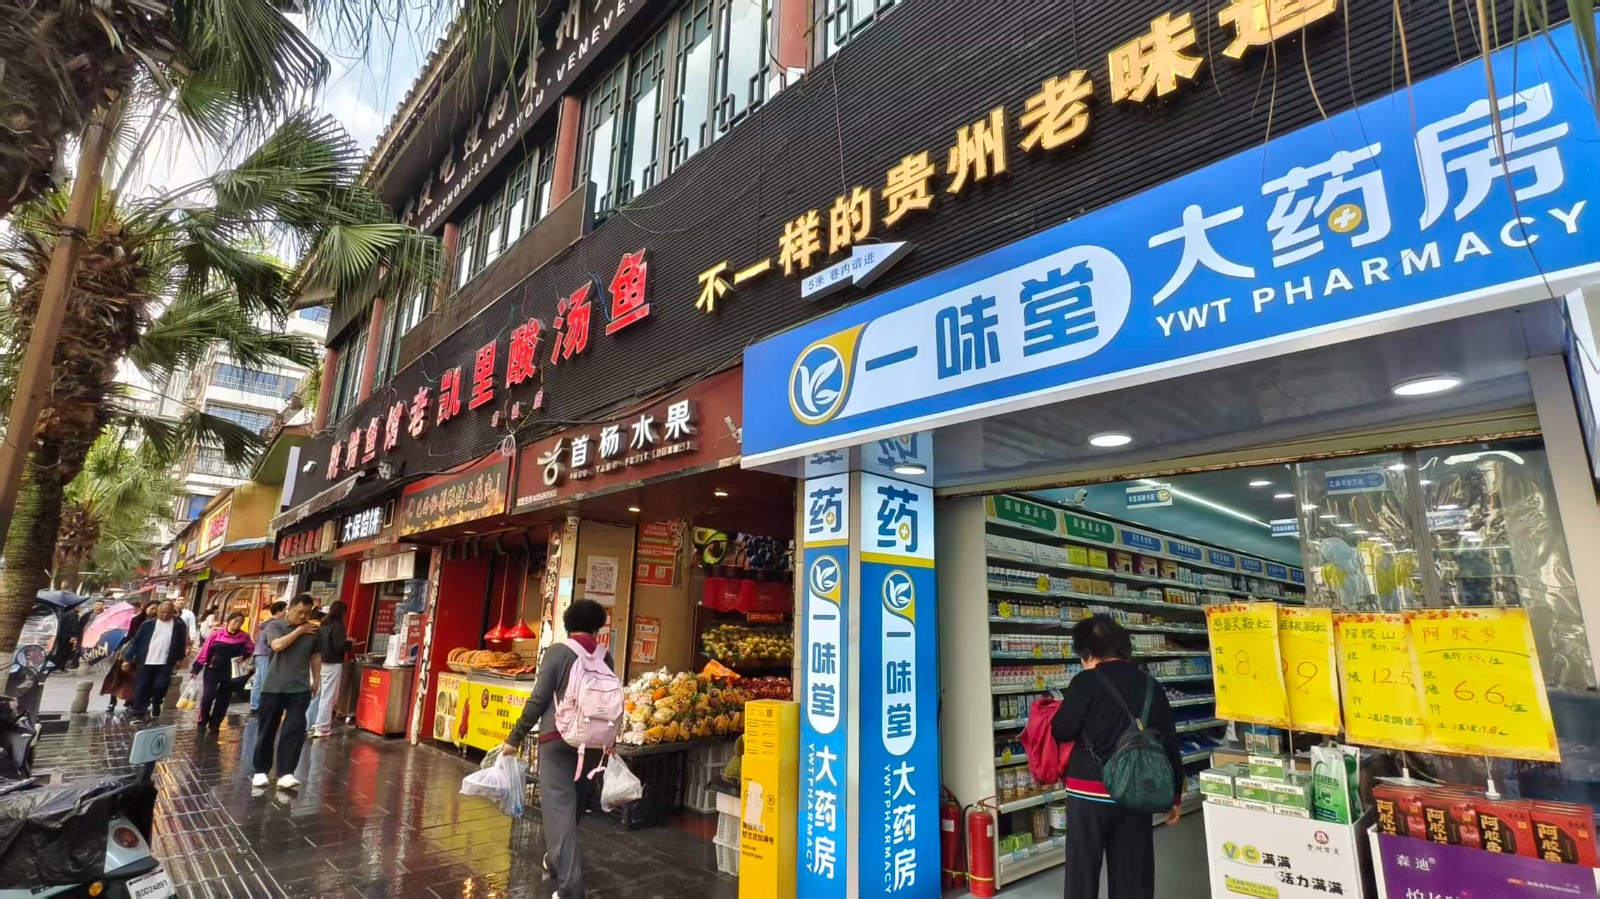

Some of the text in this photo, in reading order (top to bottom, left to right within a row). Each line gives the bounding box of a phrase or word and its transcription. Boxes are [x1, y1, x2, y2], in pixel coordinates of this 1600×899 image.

[695, 0, 1338, 314] 不一样的贵州老味道
[808, 251, 876, 291] 5米 巷内请进
[866, 81, 1569, 380] 一味堂 大药房
[1155, 200, 1588, 339] YWT PHARMACY
[570, 398, 692, 469] 首杨水果
[809, 486, 843, 534] 药
[877, 484, 919, 553] 药
[811, 614, 837, 719] 一味堂
[886, 631, 913, 740] 一味堂
[1345, 628, 1408, 640] 阿胶山
[805, 743, 815, 873] YWT PHARMACY
[813, 745, 838, 879] 大药房
[883, 763, 893, 894] YWT PHARMACY
[892, 761, 918, 892] 大药房
[1280, 870, 1344, 896] 活力满满
